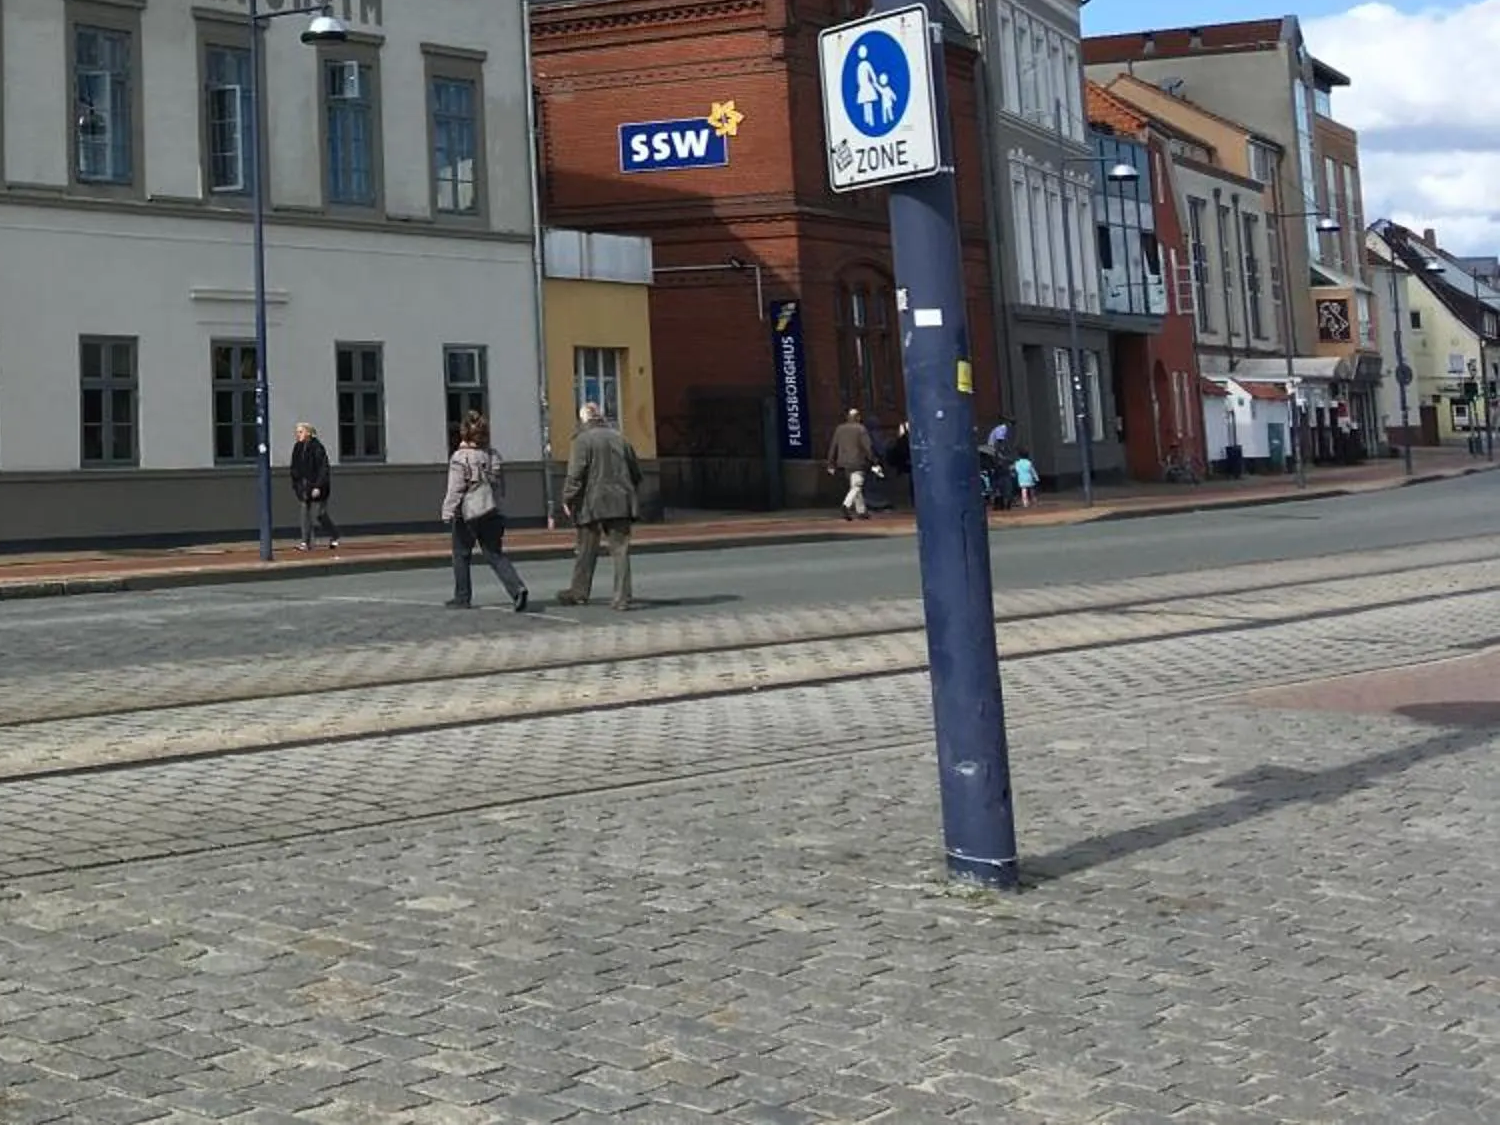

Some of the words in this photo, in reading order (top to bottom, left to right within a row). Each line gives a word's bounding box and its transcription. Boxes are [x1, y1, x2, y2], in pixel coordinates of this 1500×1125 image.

[630, 128, 710, 163] SSW
[855, 139, 909, 174] ZONE
[781, 335, 803, 447] FLENSBORGHUS
